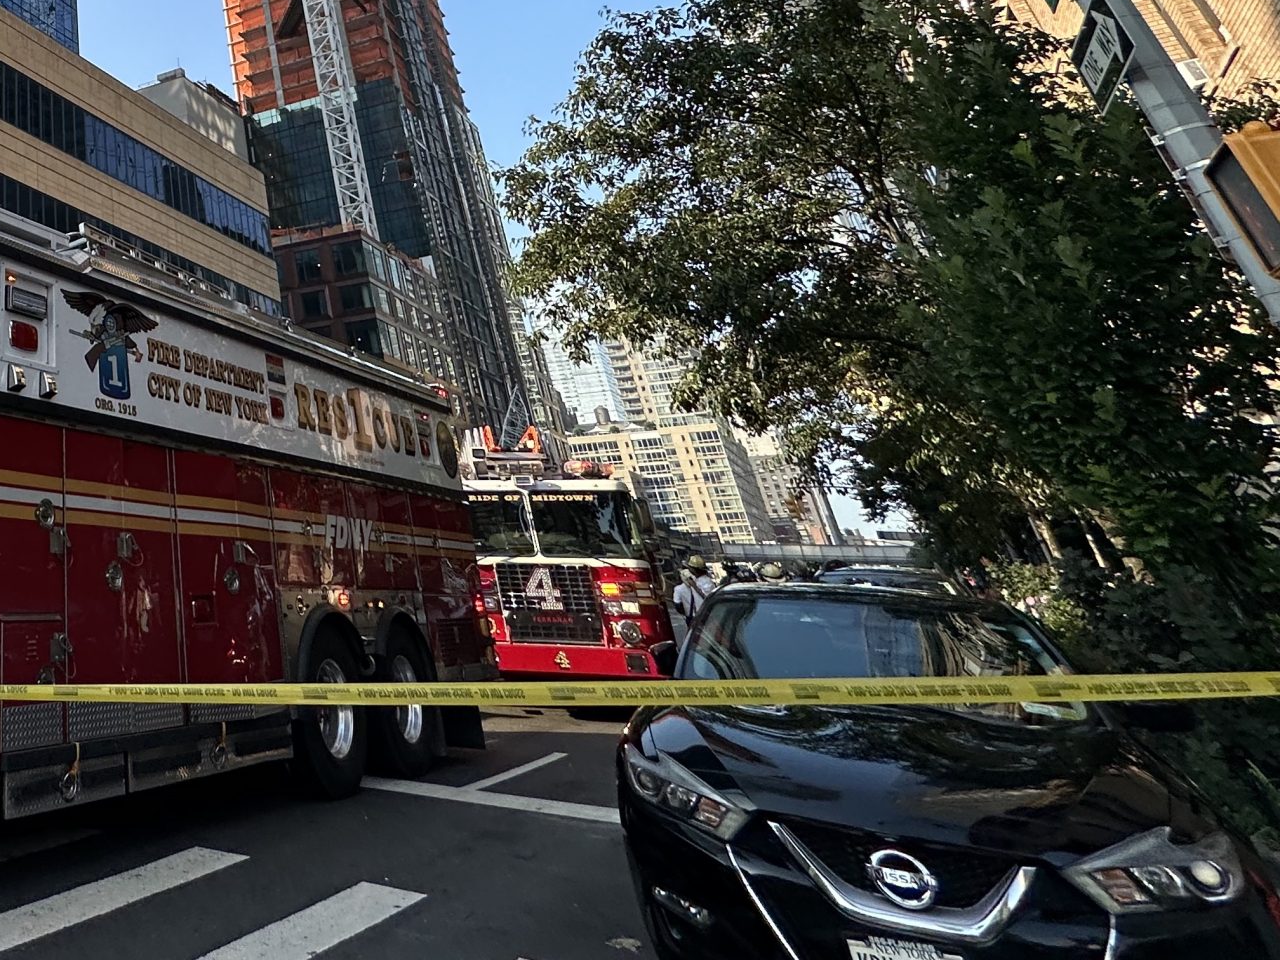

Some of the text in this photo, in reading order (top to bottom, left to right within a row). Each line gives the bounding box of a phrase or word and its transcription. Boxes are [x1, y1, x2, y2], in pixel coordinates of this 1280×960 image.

[1084, 18, 1116, 88] ONE WAY
[107, 355, 123, 387] 1
[147, 338, 265, 395] FIRE DEPARTMENT
[95, 397, 116, 412] ORG.
[147, 372, 270, 425] CITY OF NEW YORK
[504, 494, 520, 502] OF
[531, 494, 594, 502] MIDTOWN
[325, 514, 373, 551] FDNY
[526, 567, 564, 610] 4
[554, 650, 572, 669] 4
[874, 869, 931, 889] NISSAN
[874, 942, 900, 955] NEW
[900, 945, 938, 960] YORK
